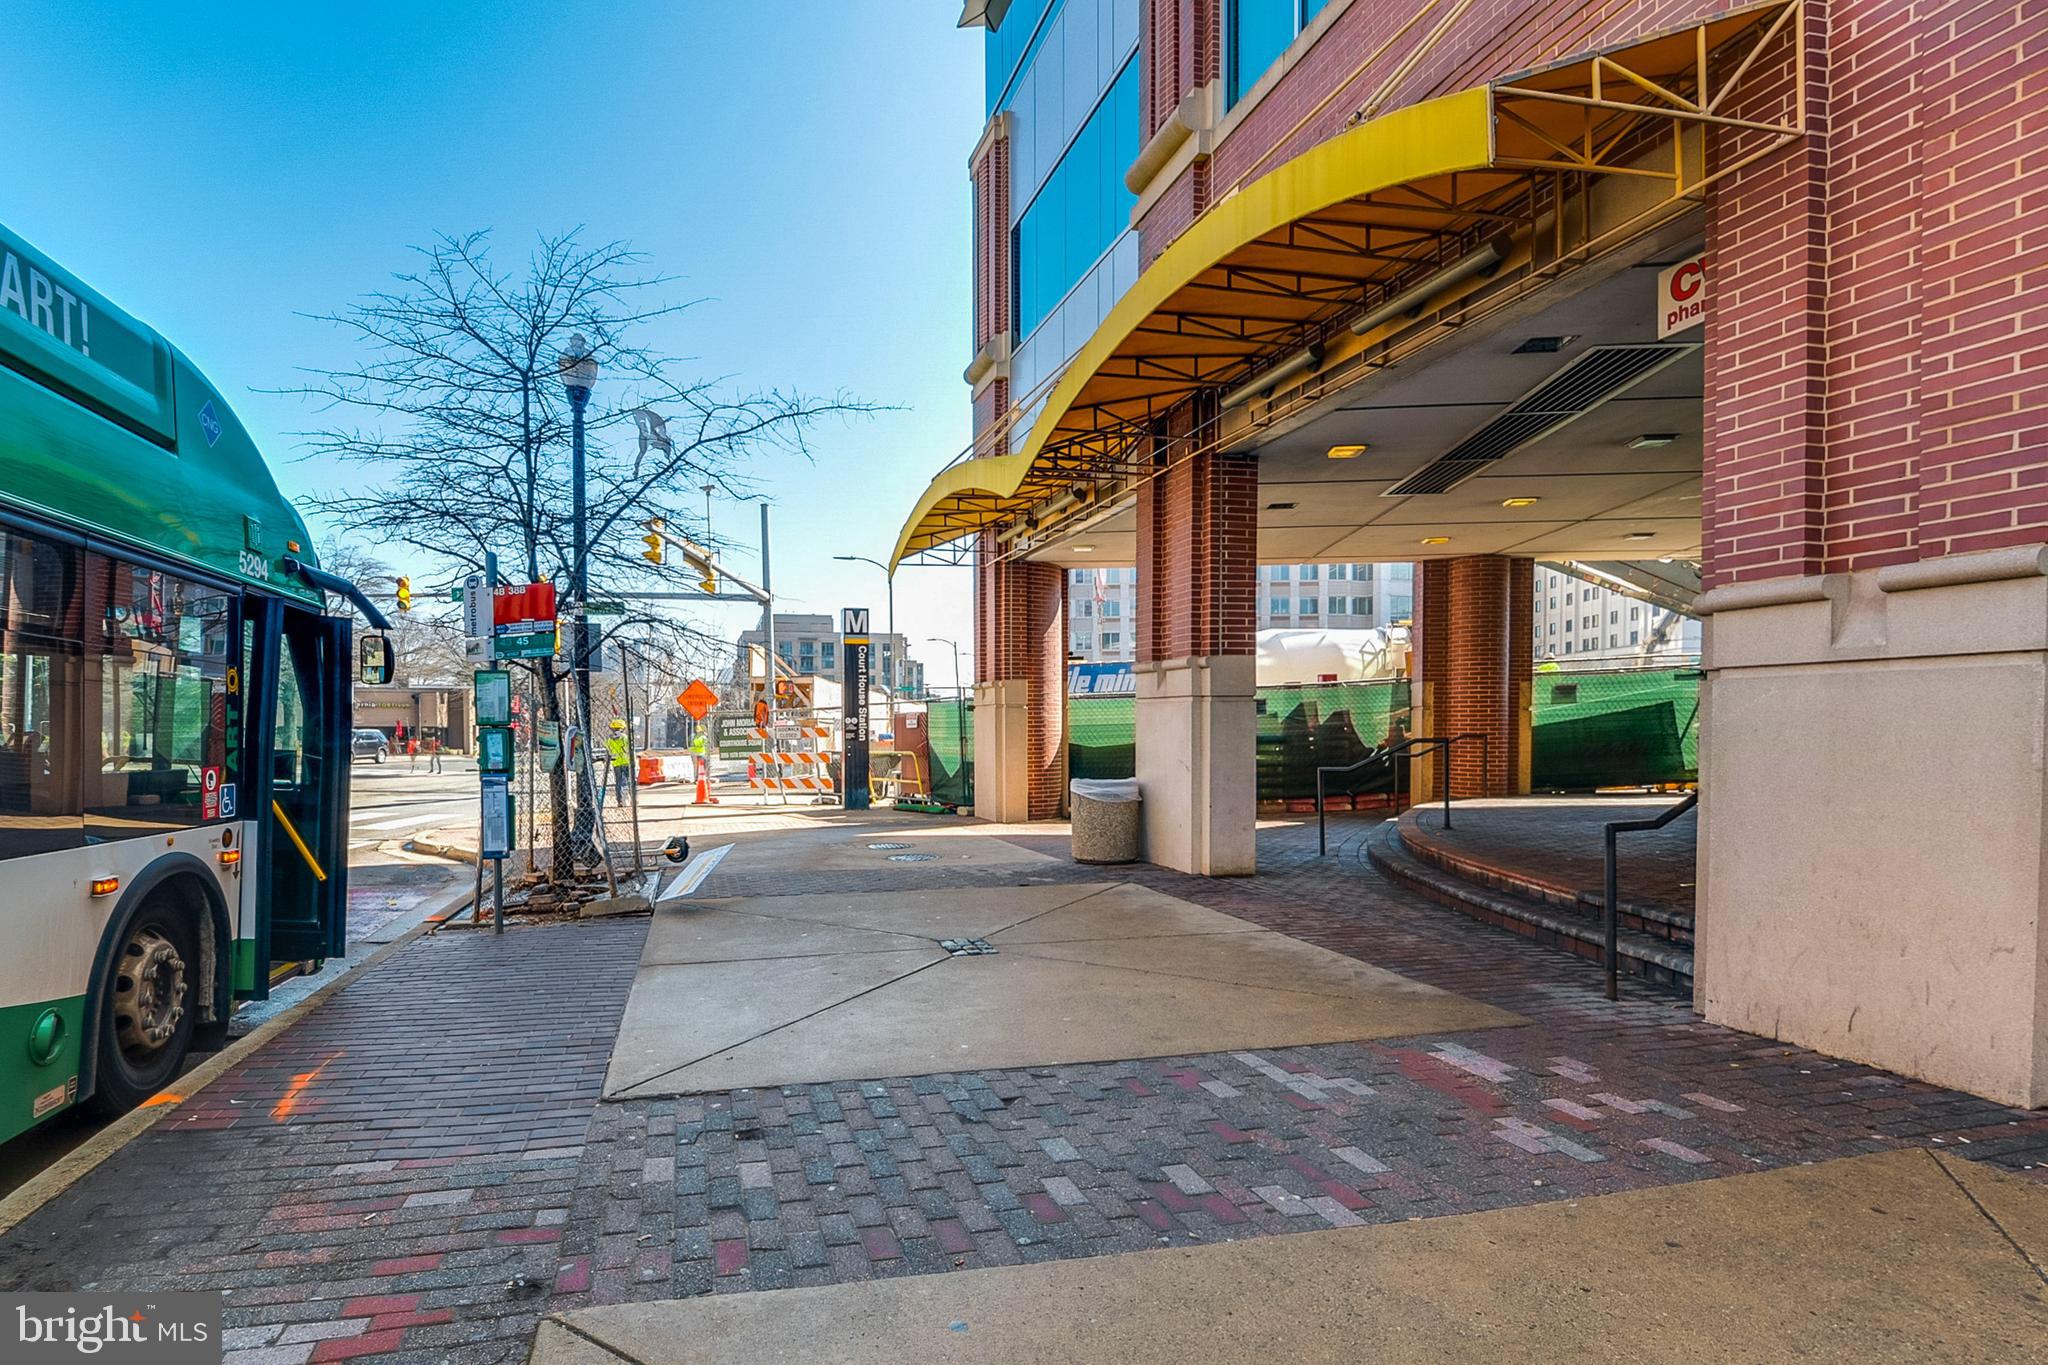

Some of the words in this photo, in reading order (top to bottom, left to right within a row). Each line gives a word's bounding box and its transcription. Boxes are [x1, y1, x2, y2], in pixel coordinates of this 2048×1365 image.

[0, 251, 89, 357] ART!
[201, 413, 219, 434] CNG
[239, 550, 268, 581] 5294
[845, 610, 868, 633] M
[516, 637, 529, 645] 45
[858, 646, 867, 673] Court
[858, 675, 867, 705] House
[721, 719, 736, 728] JOHN
[858, 708, 867, 741] Station
[226, 704, 239, 772] ART
